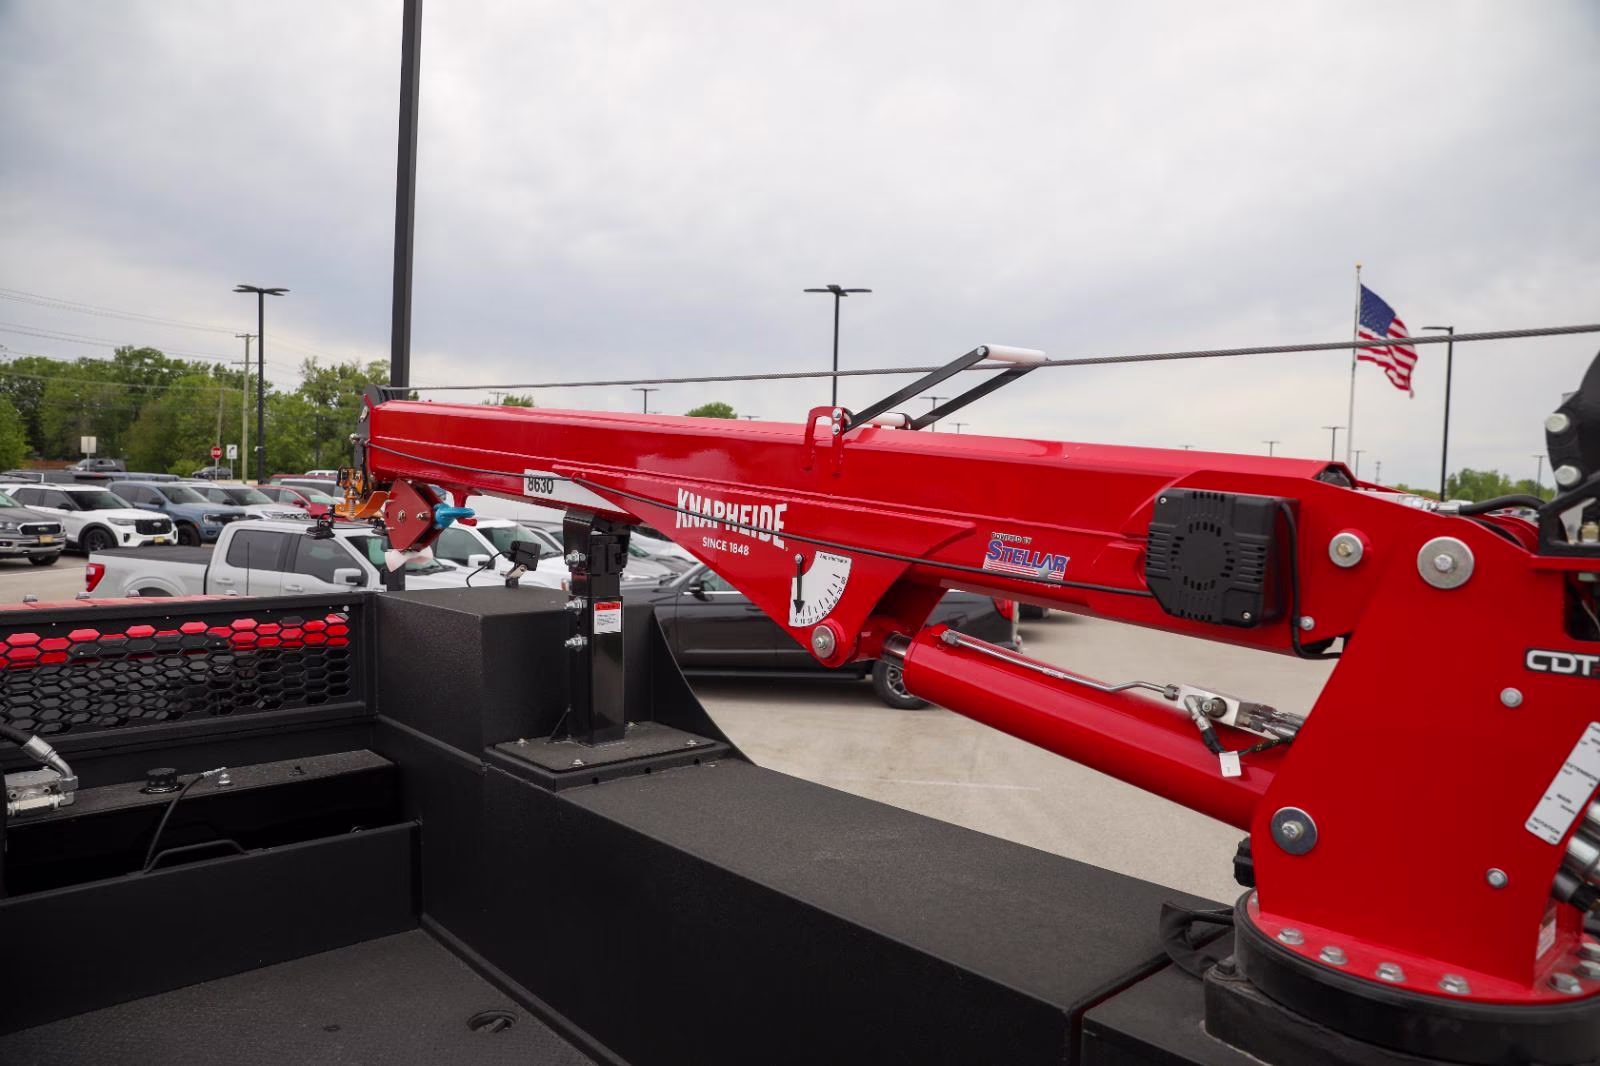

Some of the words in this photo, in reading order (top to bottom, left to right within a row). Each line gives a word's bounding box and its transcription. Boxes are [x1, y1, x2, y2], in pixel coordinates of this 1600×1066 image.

[528, 475, 554, 494] 8630
[676, 488, 787, 549] KNAPHEIDE
[702, 536, 727, 551] SINCE
[729, 542, 750, 556] 1848
[987, 540, 1070, 572] STELLAR
